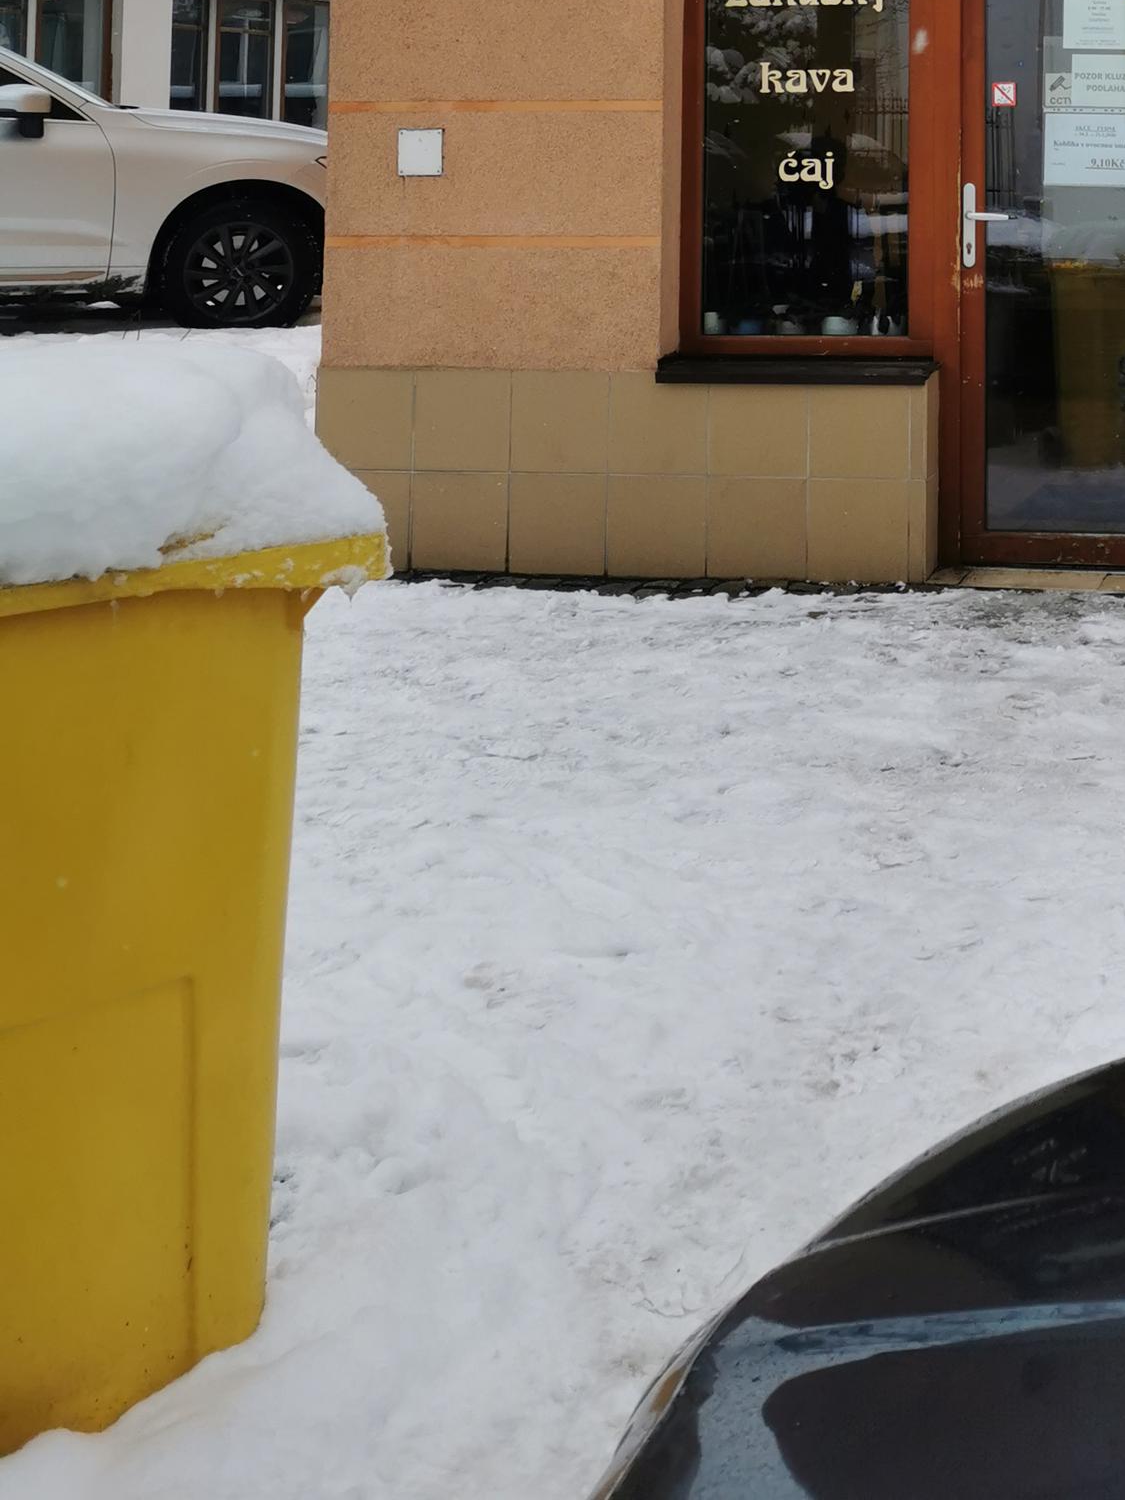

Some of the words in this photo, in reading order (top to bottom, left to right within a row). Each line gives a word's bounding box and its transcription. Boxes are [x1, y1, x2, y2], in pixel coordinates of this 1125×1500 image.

[759, 62, 855, 93] kava
[1074, 72, 1103, 81] POZOR
[1086, 84, 1125, 92] PODLAHA
